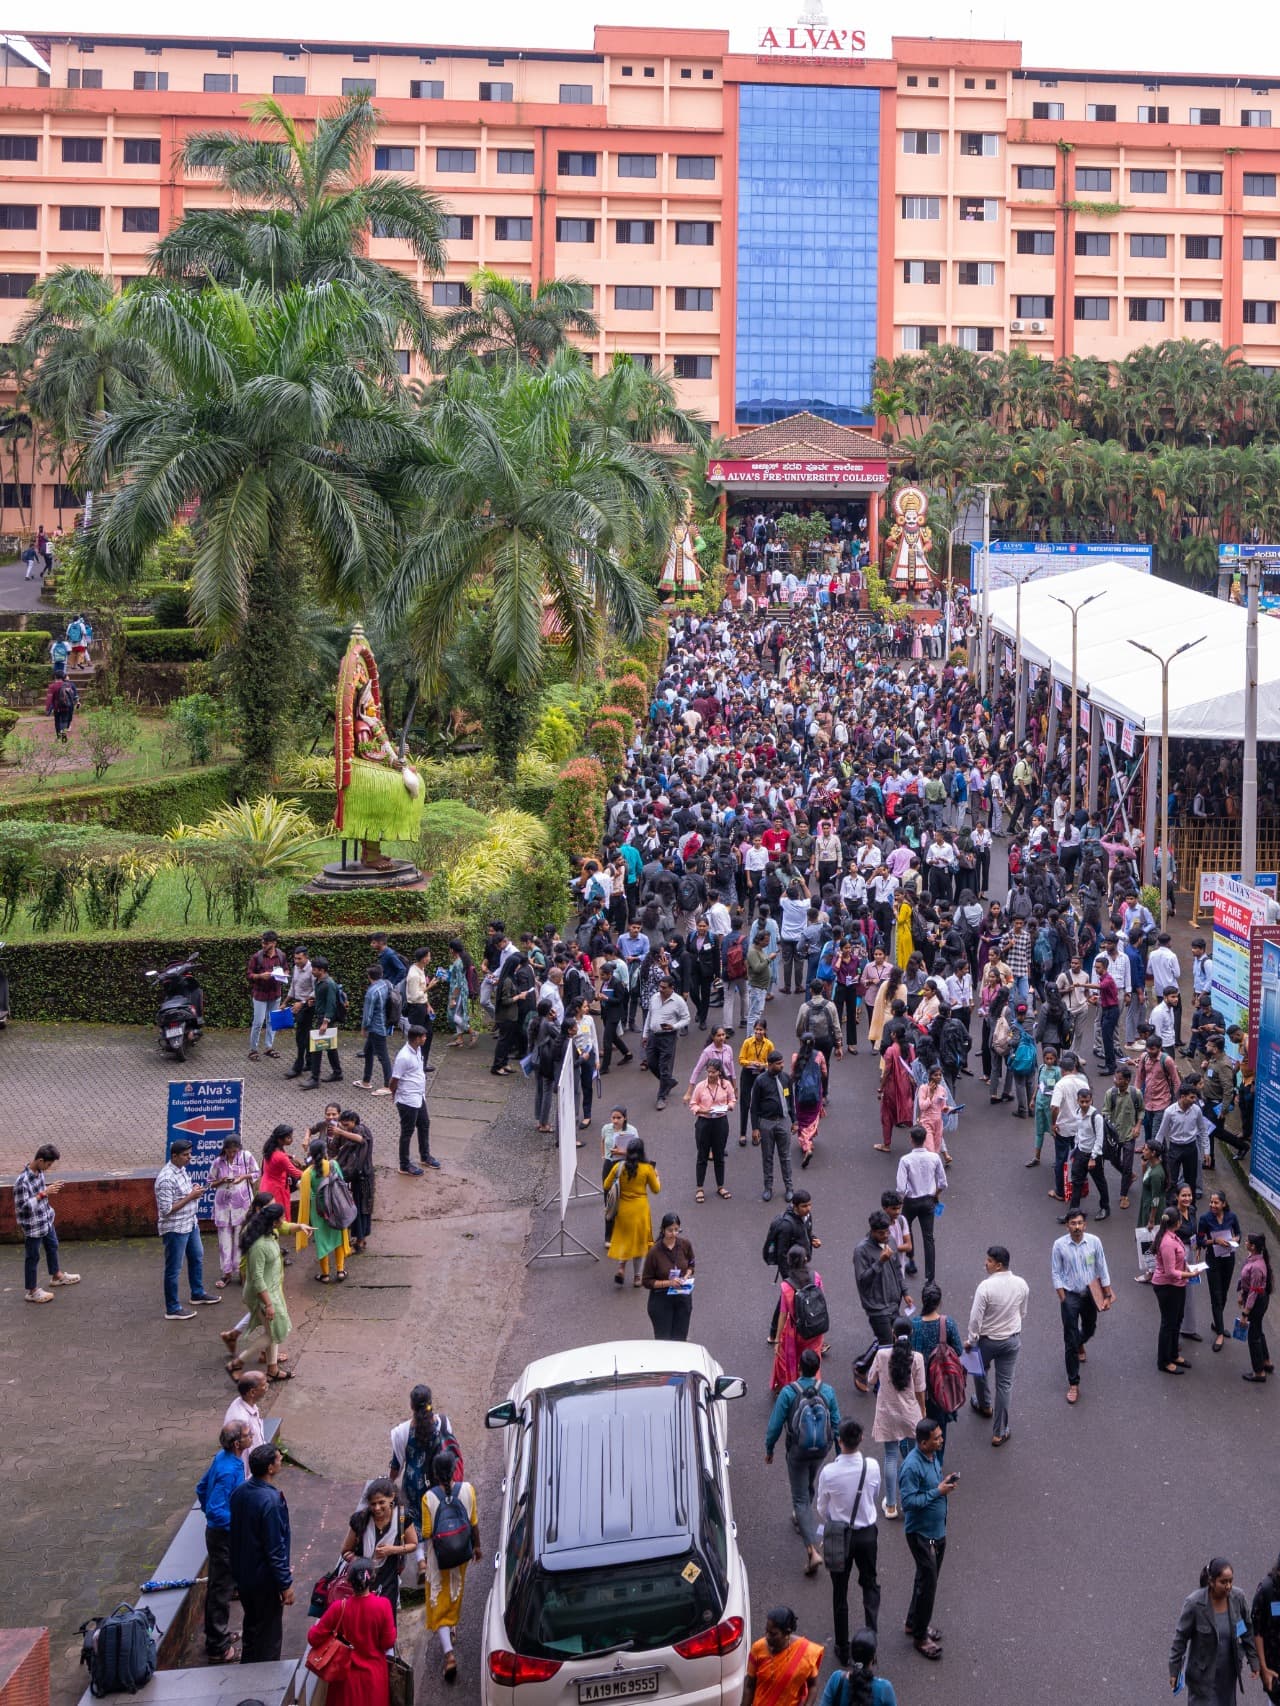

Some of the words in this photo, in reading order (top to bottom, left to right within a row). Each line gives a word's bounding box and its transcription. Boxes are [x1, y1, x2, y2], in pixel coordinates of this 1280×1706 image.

[758, 26, 866, 51] ALVA'S
[727, 473, 760, 481] ALVA'S
[763, 473, 840, 481] PRE-UNIVERSITY
[842, 474, 885, 482] COLLEGE
[1227, 880, 1250, 899] ALVA'S
[1214, 898, 1227, 912] WE
[1227, 905, 1242, 919] ARE
[1222, 914, 1248, 935] HIRING
[198, 1085, 232, 1096] Alva's
[184, 1105, 225, 1113] Moodubidire
[586, 1684, 611, 1699] KA19
[614, 1681, 626, 1695] MG
[629, 1677, 655, 1692] 9555
